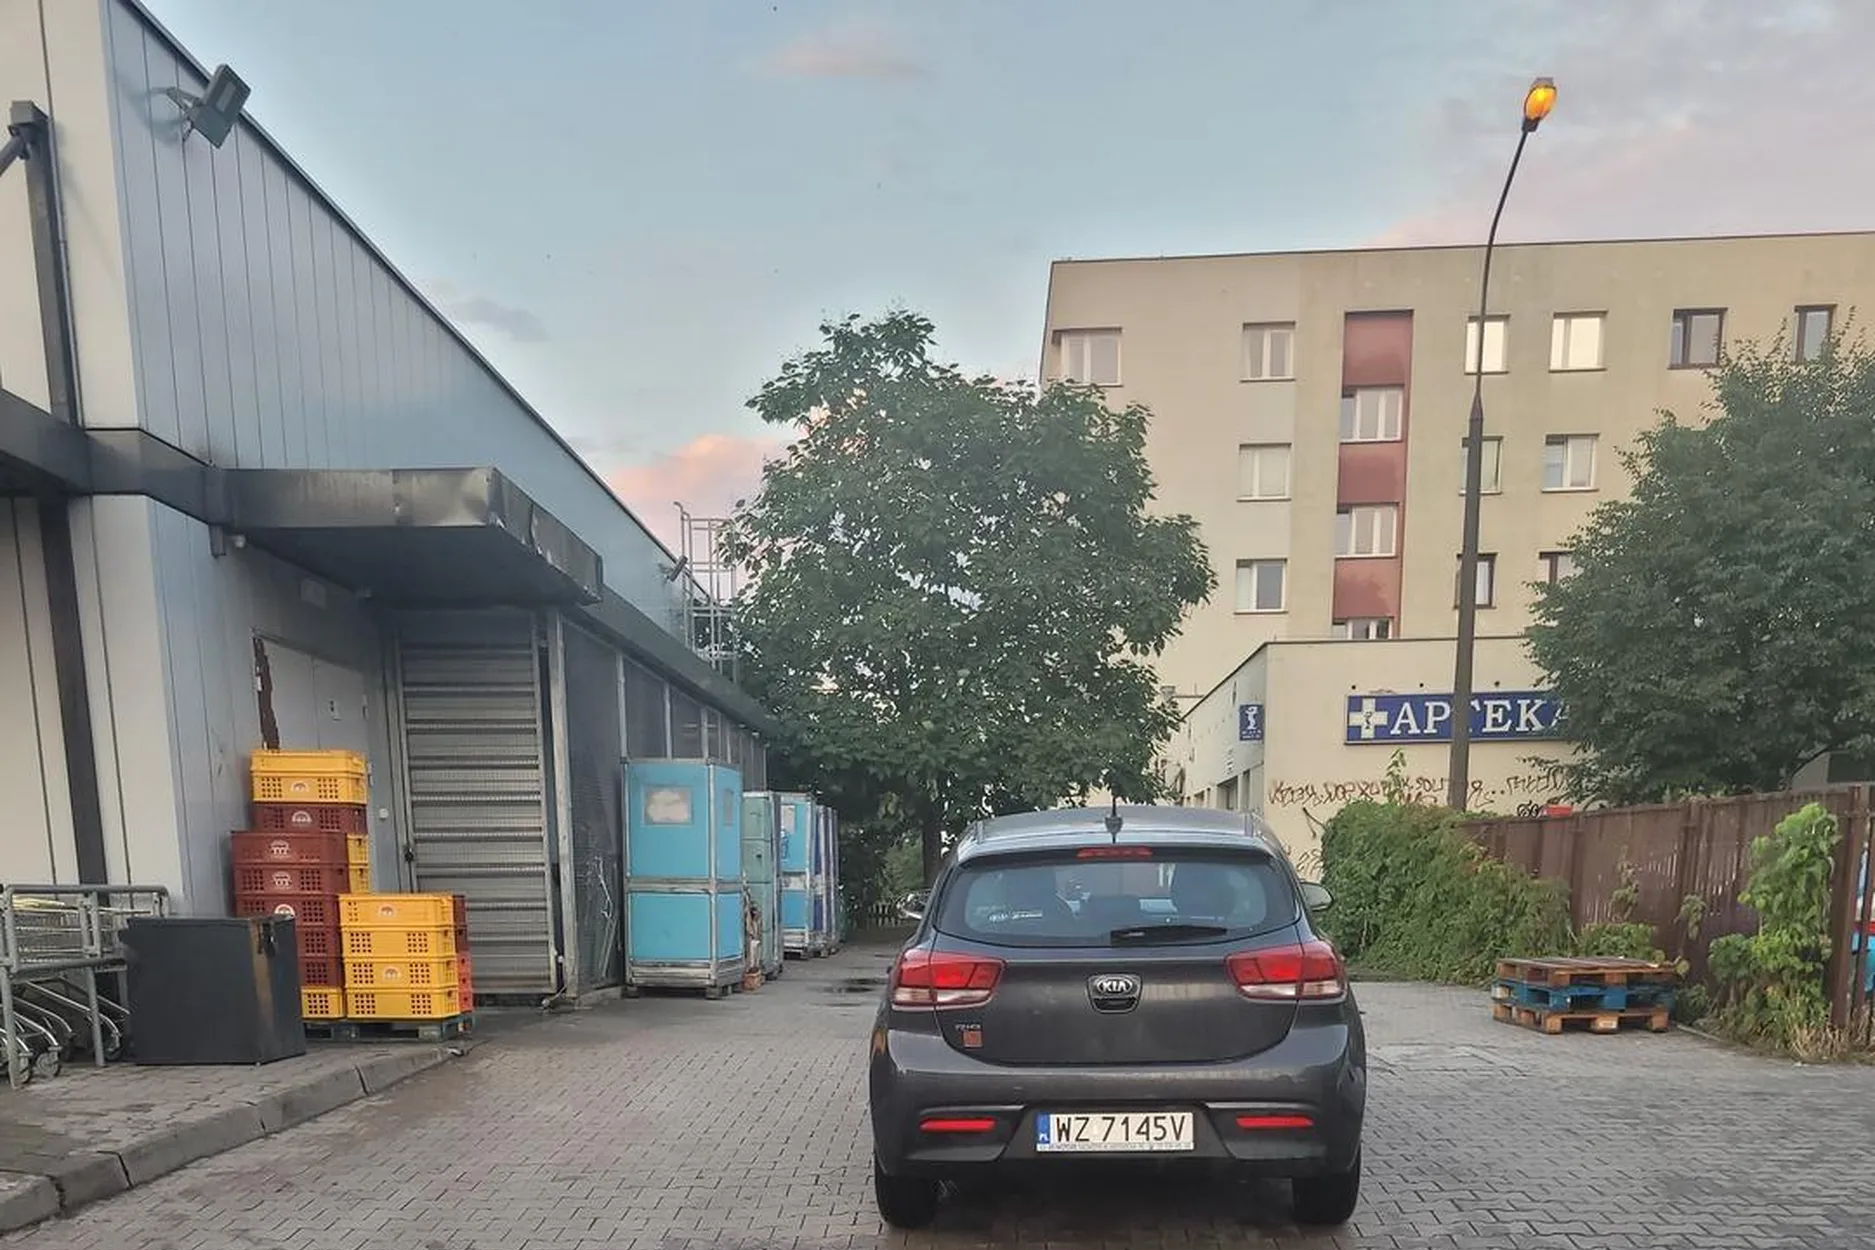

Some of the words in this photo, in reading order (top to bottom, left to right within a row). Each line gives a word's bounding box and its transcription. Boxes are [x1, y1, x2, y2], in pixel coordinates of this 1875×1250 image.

[1390, 699, 1569, 735] APEKA
[1056, 1116, 1090, 1142] WZ
[1101, 1115, 1186, 1142] 7145V
